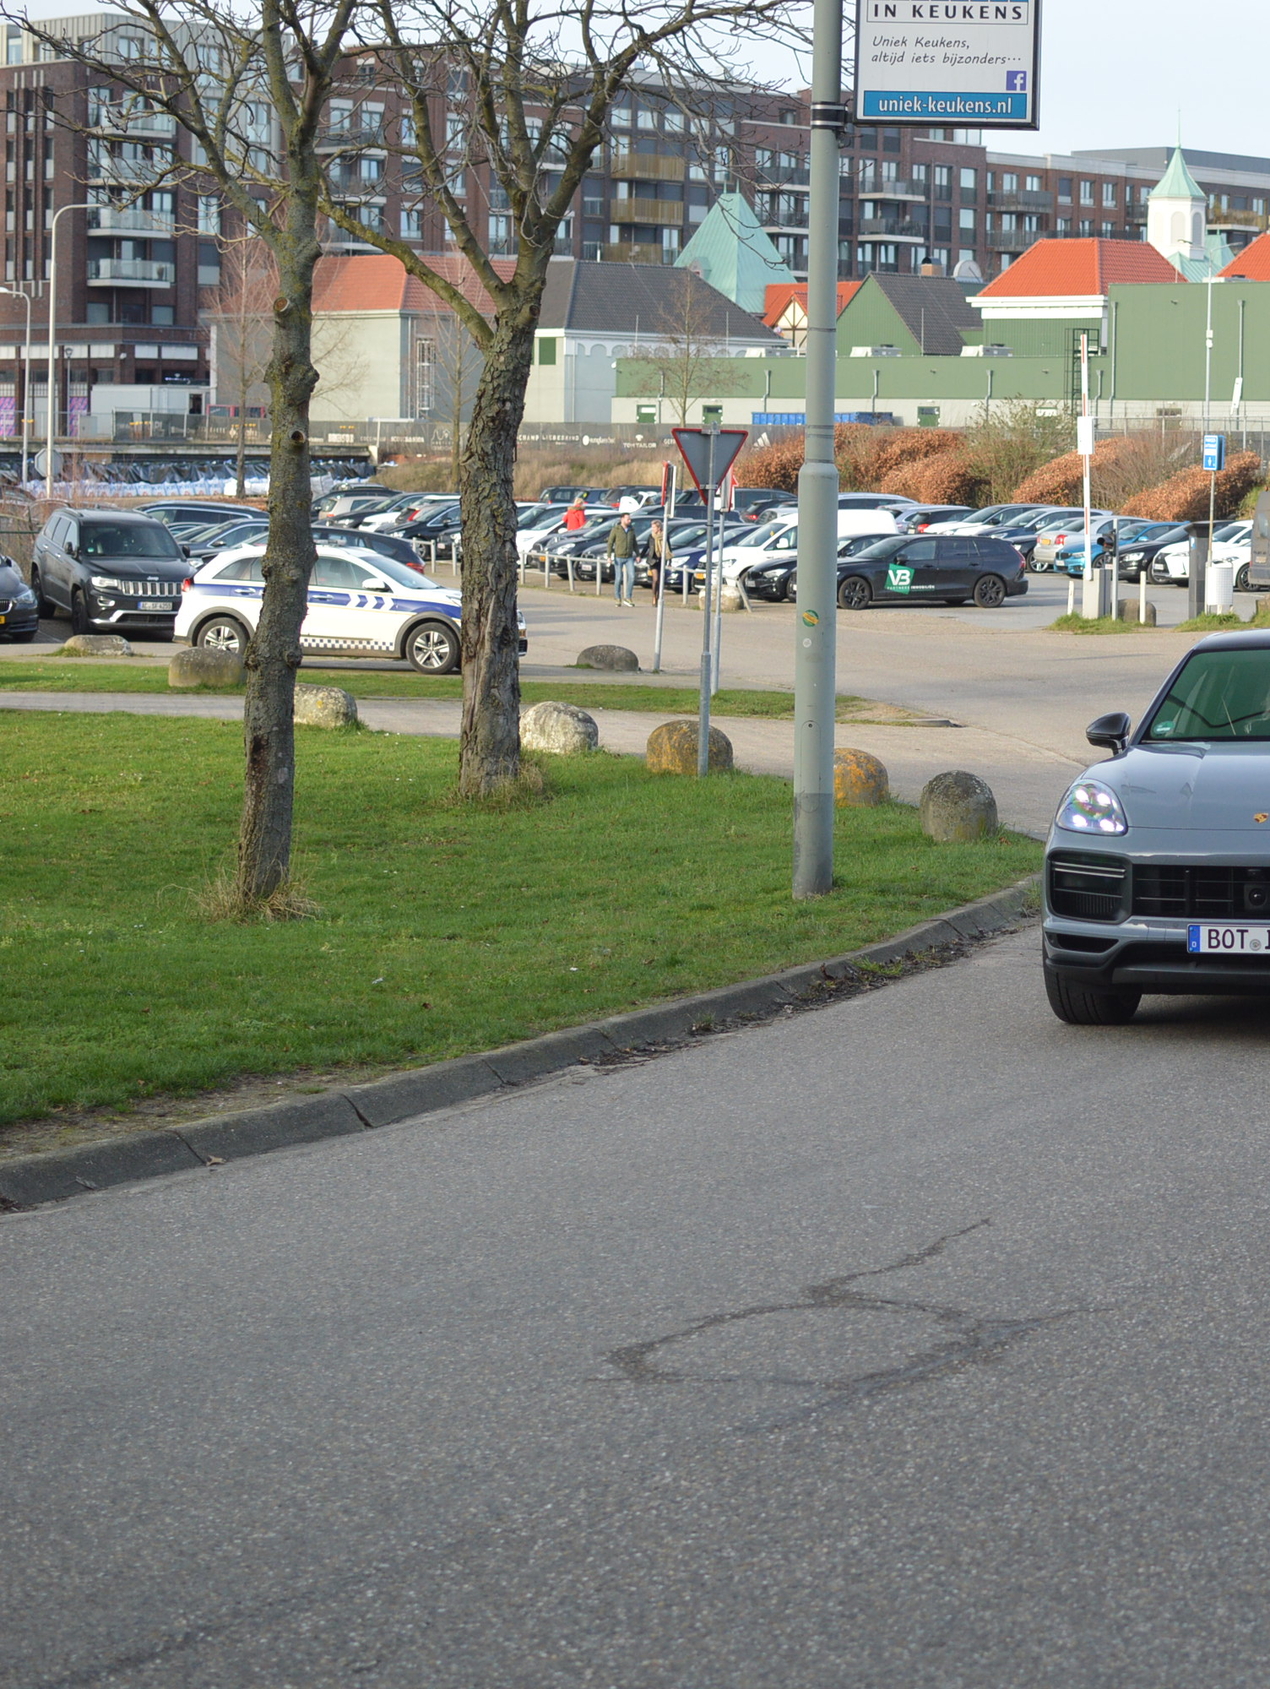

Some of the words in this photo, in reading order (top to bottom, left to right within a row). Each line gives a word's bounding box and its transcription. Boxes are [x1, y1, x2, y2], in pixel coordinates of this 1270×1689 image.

[873, 3, 897, 18] IN
[912, 4, 1023, 21] KEUKENS
[872, 35, 908, 49] Uniek
[914, 36, 970, 51] Keukens,
[871, 51, 905, 66] altijd
[910, 52, 936, 65] iets
[878, 95, 1013, 115] uniek-keukens.nl
[1207, 928, 1249, 949] BOT
